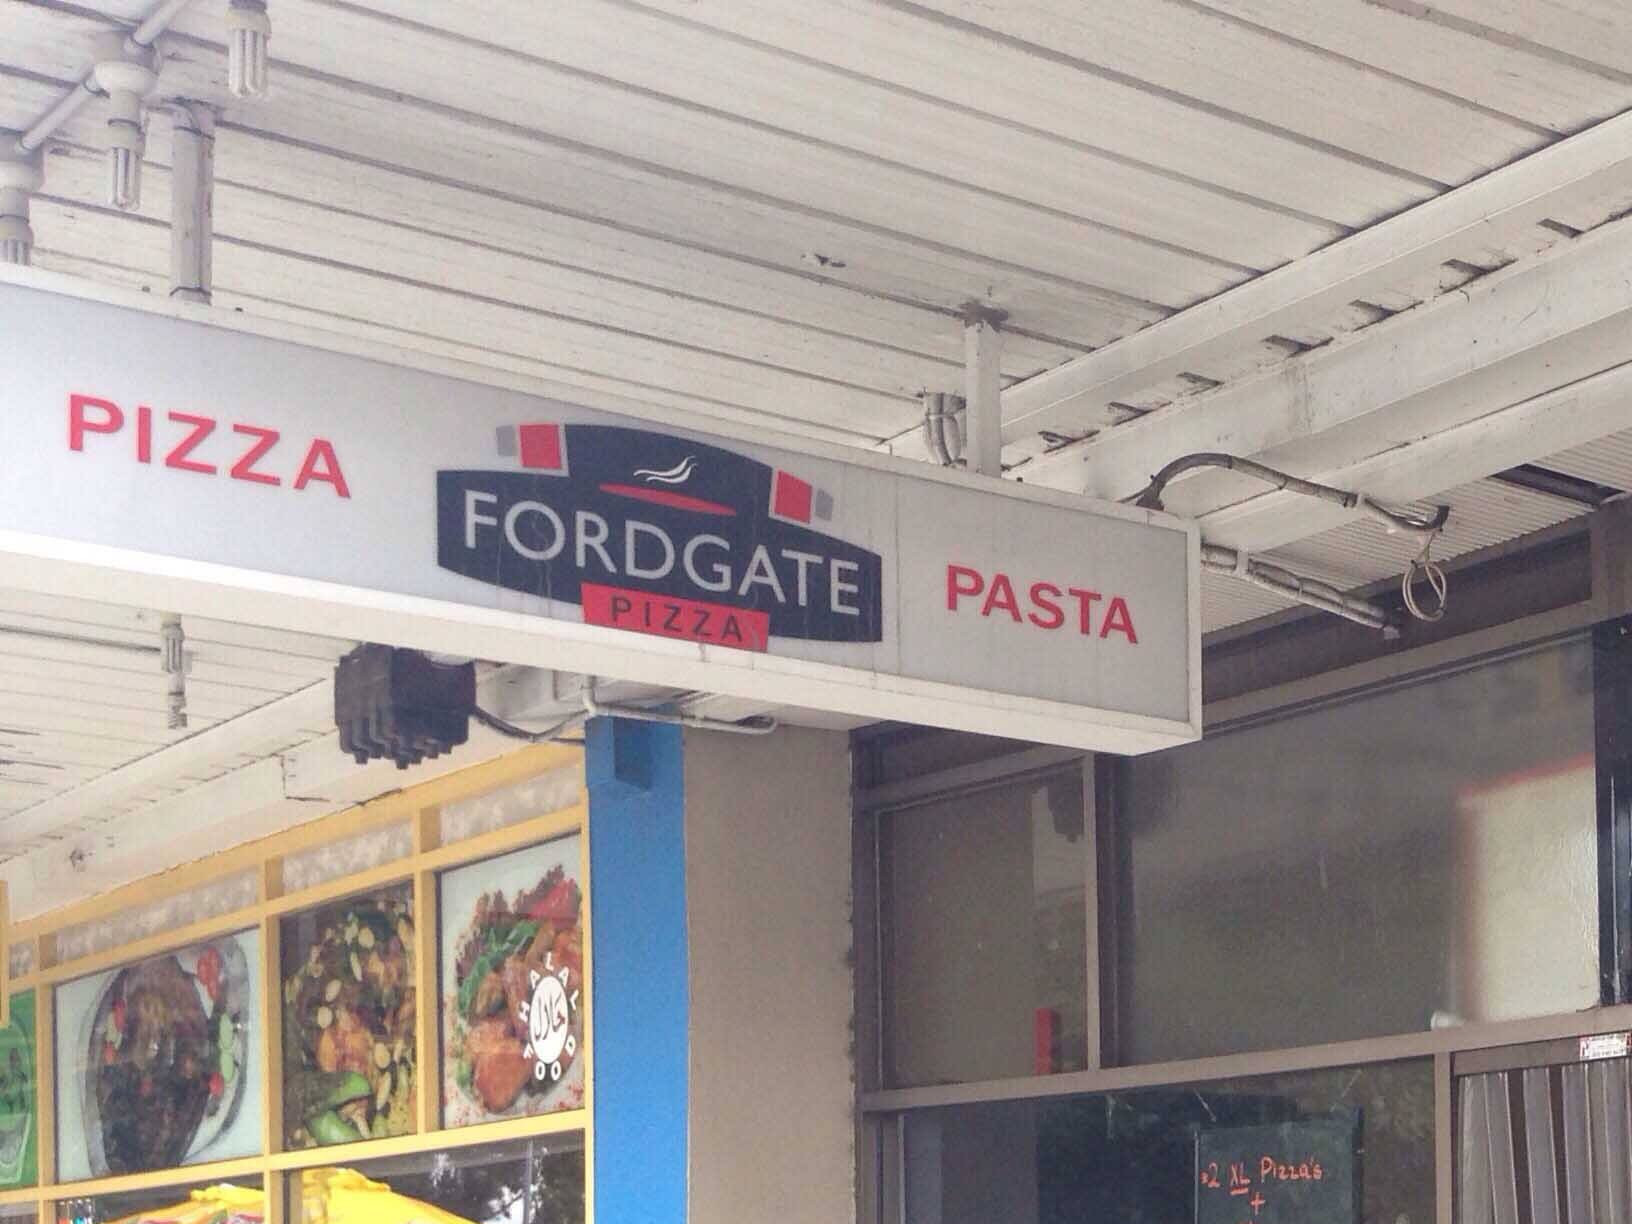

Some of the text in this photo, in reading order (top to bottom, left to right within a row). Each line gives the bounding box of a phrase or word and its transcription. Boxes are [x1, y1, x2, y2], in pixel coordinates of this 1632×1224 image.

[66, 394, 352, 499] PIZZA
[464, 489, 861, 617] FORDGATE
[610, 594, 744, 643] PIZZA
[946, 563, 1139, 645] PASTA
